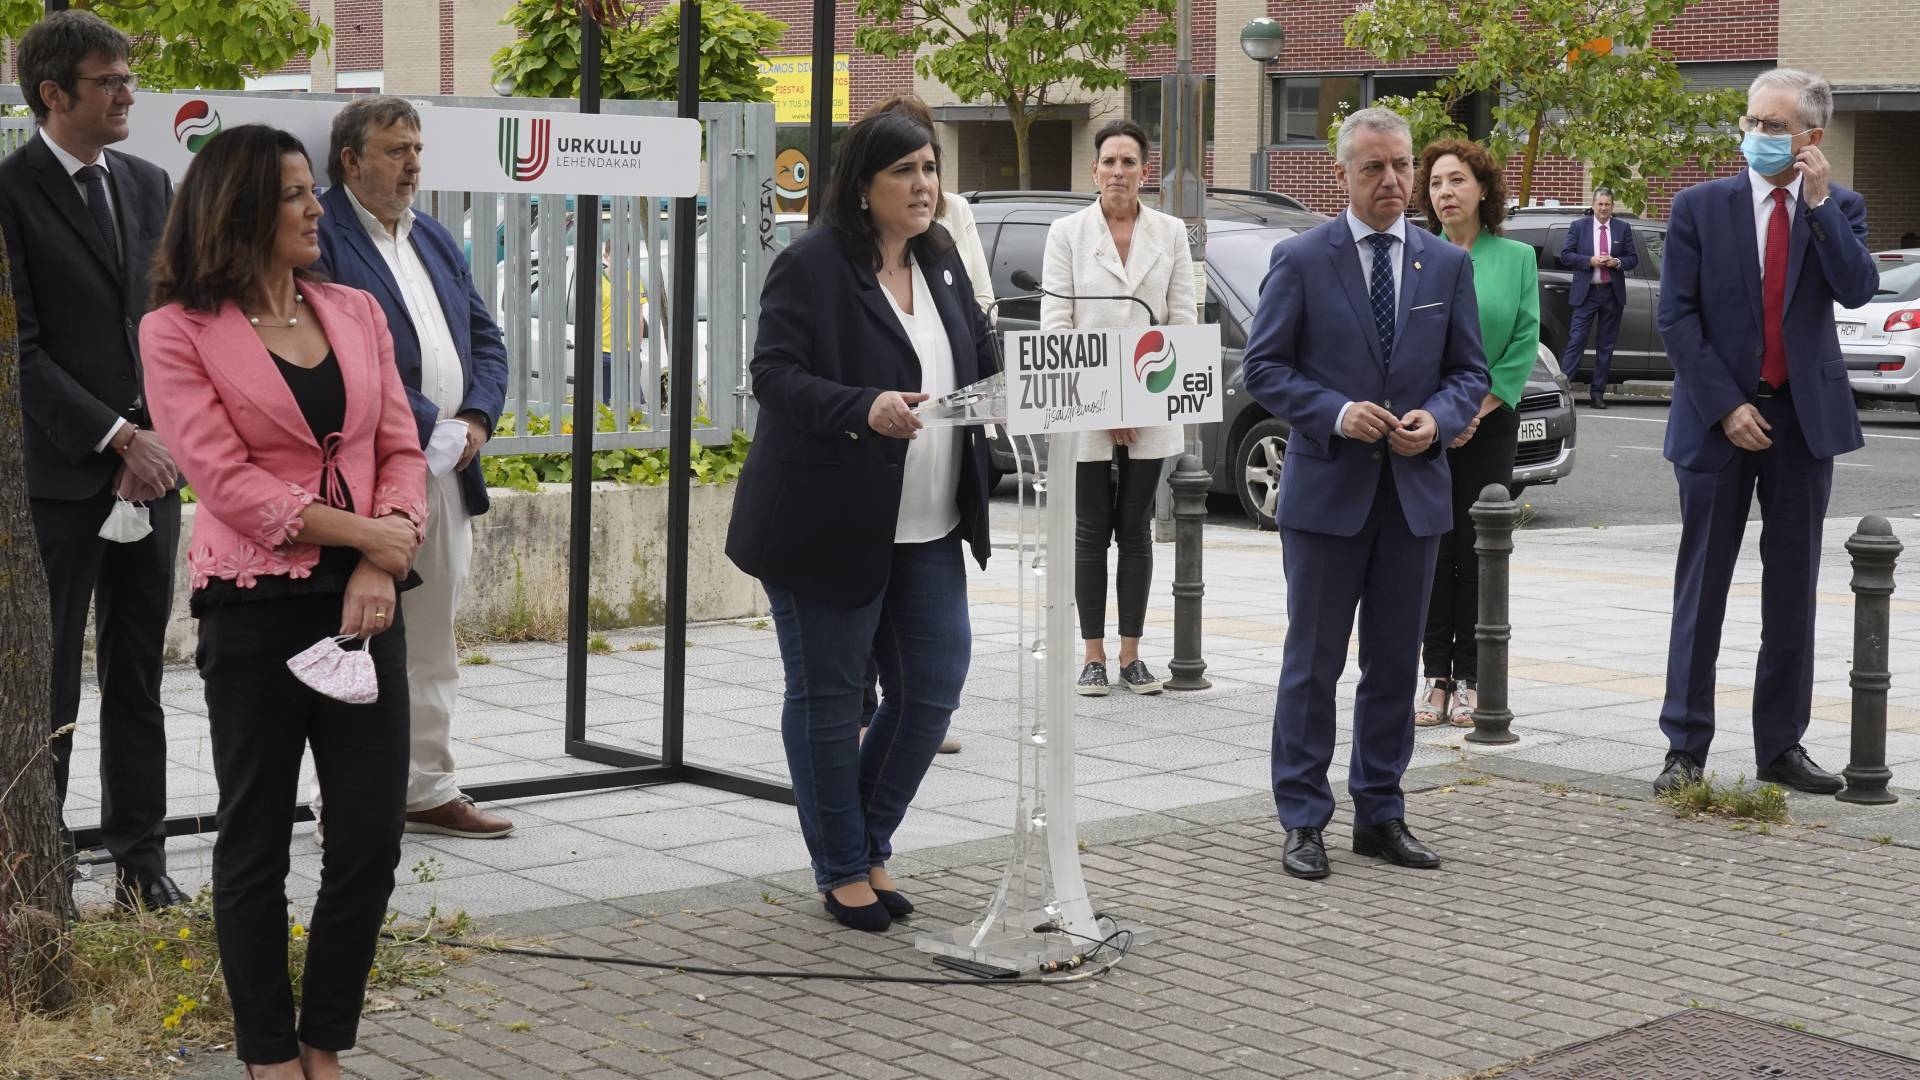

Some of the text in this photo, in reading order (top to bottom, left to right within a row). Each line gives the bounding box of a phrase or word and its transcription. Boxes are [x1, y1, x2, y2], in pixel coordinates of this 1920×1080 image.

[775, 86, 805, 95] FIESTAS
[557, 137, 642, 155] URKULLU
[556, 156, 642, 169] LEHENDAKARI
[1019, 333, 1108, 371] EUSKADI
[1019, 371, 1083, 410] ZUTIK
[1182, 365, 1213, 398] eaj
[1167, 393, 1207, 421] pnv
